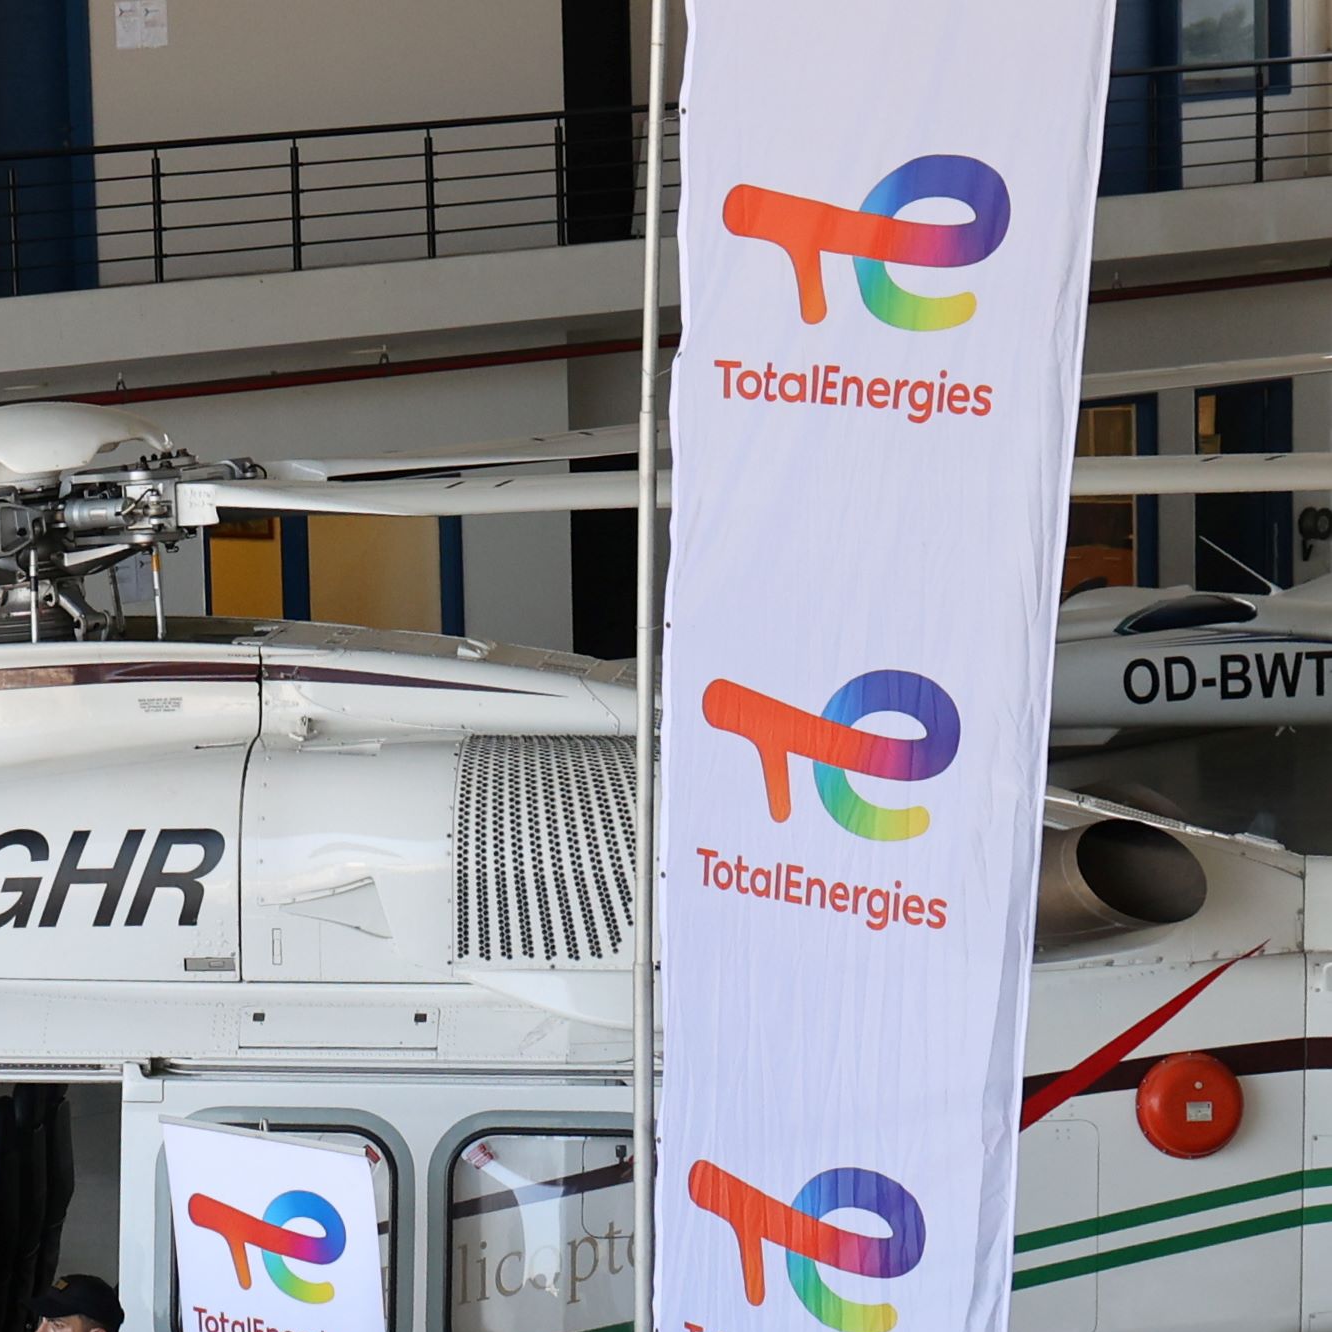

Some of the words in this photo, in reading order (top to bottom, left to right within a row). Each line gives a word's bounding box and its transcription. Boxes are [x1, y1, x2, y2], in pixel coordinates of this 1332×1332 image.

[714, 359, 993, 424] TotalEnergies
[1123, 651, 1332, 705] OD-BWT
[696, 847, 948, 931] TotalEnergies
